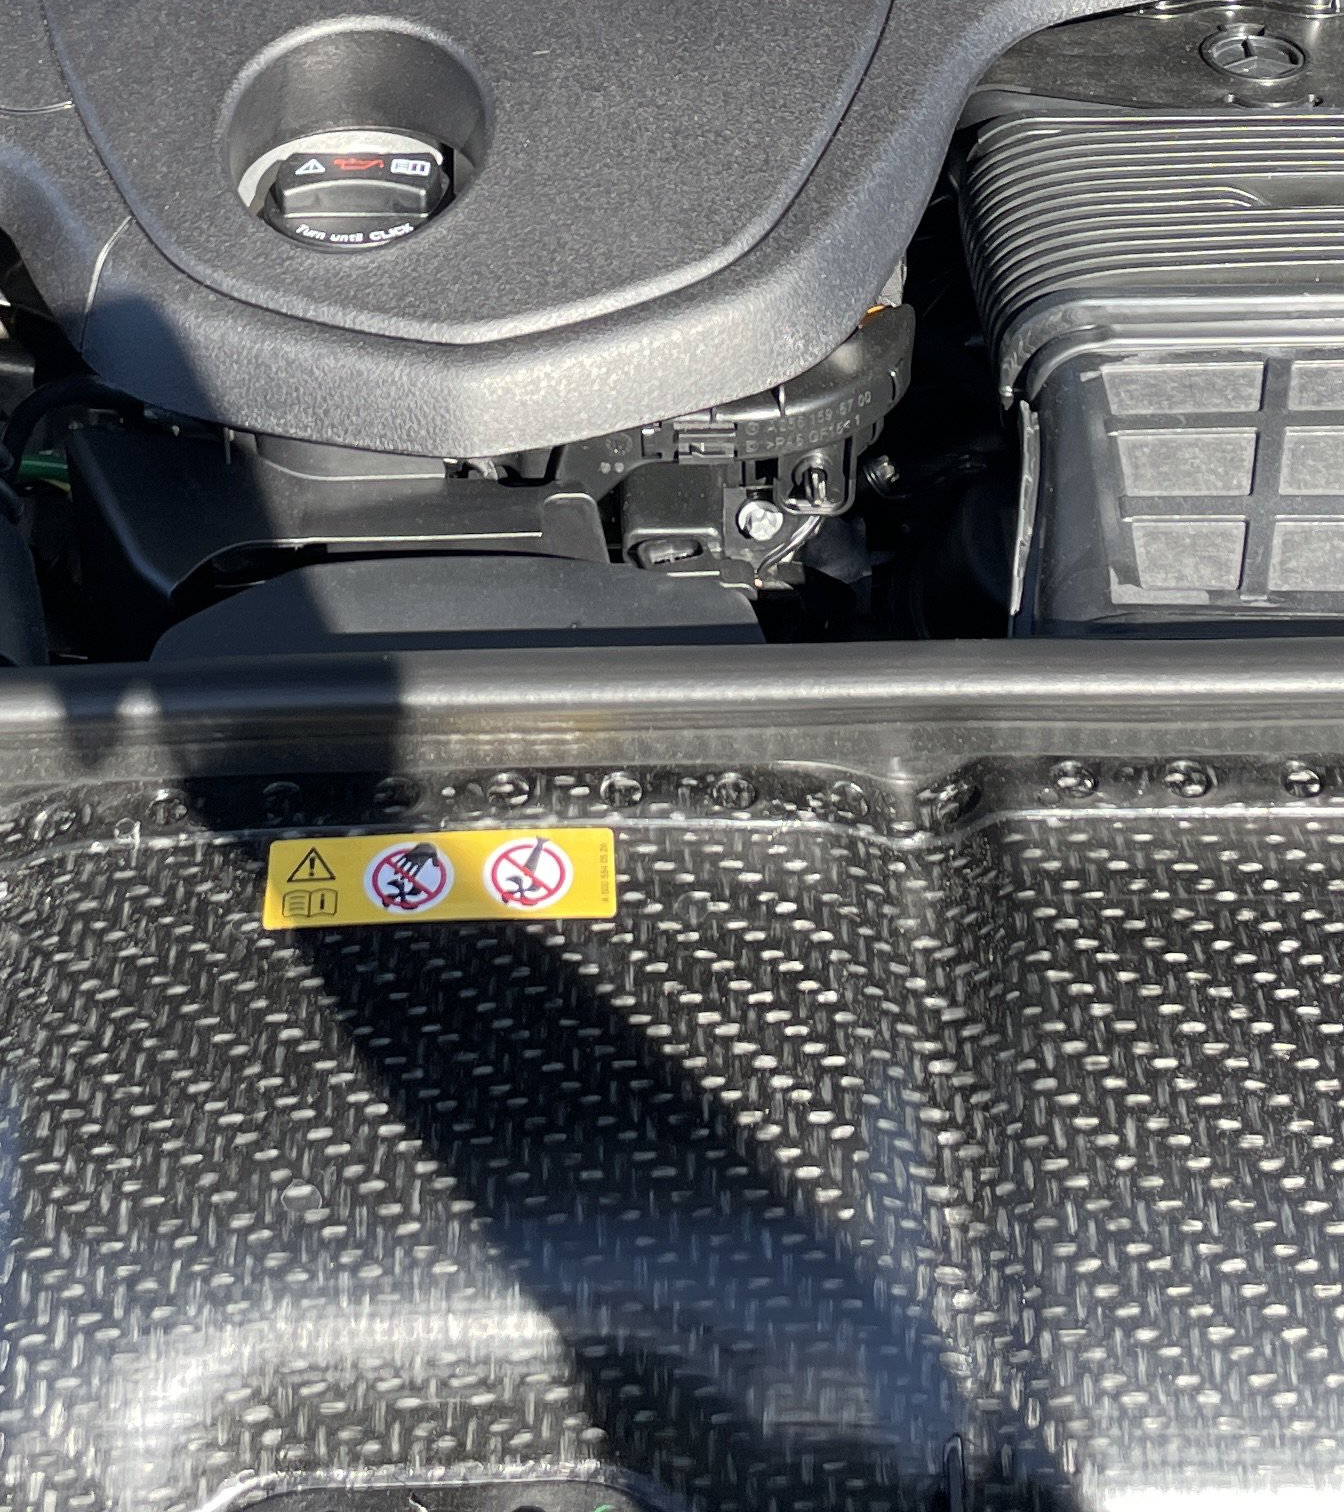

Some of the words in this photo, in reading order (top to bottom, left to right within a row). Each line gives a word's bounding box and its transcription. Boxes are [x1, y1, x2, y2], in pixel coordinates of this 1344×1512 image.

[295, 224, 326, 240] Turn
[329, 232, 364, 243] until
[369, 222, 414, 241] CLICK
[858, 391, 872, 407] 00
